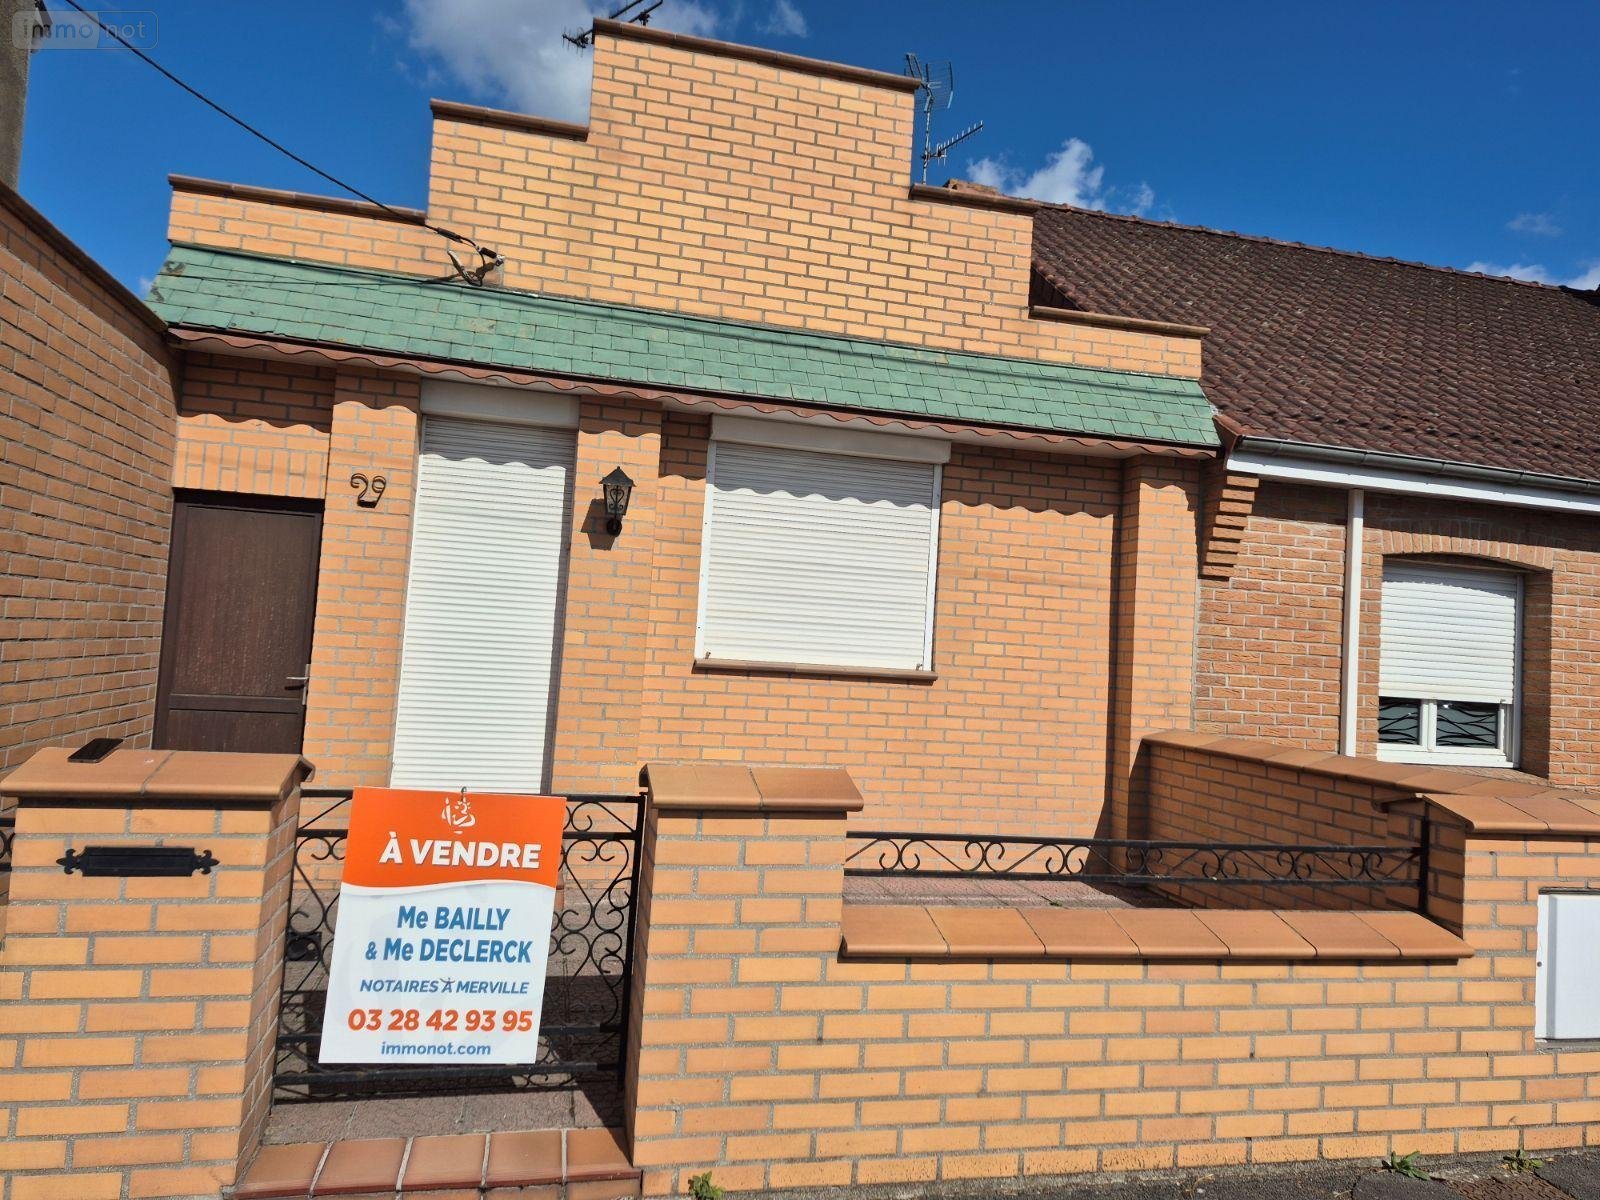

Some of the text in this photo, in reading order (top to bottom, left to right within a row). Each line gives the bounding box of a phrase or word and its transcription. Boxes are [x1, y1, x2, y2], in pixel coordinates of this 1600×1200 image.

[350, 473, 386, 508] 29
[379, 831, 542, 869] À VENDRE
[397, 905, 511, 931] Me BAILLY
[365, 938, 533, 963] & Me DECLERCK
[359, 979, 439, 993] NOTAIRES
[456, 980, 529, 994] MERVILLE
[348, 1008, 533, 1032] 03 28 42 93 95
[381, 1041, 491, 1055] immonot.com
